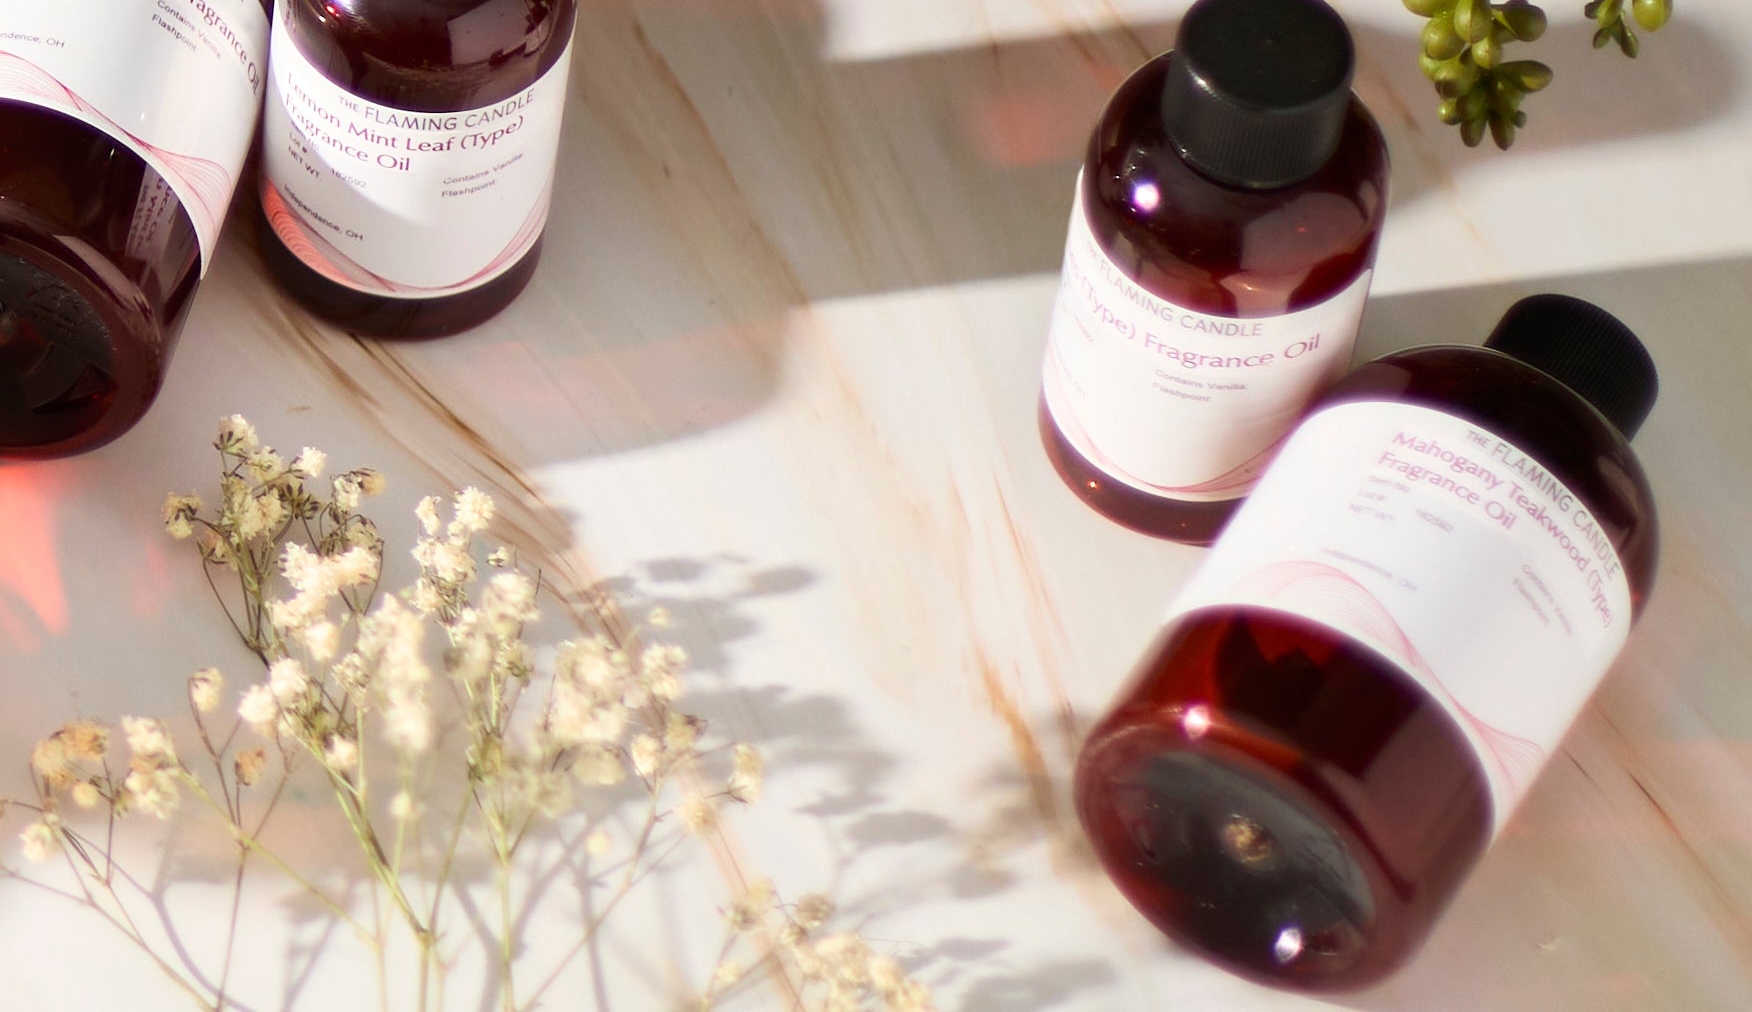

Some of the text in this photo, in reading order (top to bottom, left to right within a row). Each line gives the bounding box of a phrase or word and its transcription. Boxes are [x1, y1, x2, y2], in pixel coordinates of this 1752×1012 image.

[46, 37, 66, 49] OH
[157, 0, 196, 32] Contains
[247, 61, 260, 96] Oil
[288, 71, 524, 152] Lemon Mint Leaf (Type)
[339, 88, 535, 131] THE FLAMING CANDLE
[286, 93, 410, 171] Fragrance Oil
[1080, 276, 1136, 340] (Type)
[1144, 332, 1276, 369] Fragrance
[1283, 332, 1322, 359] Oil
[1099, 258, 1175, 323] FLAMING
[1180, 314, 1264, 338] CANDLE
[1378, 450, 1518, 530] Fragrance Oil
[1392, 430, 1504, 491] Mahogany
[1507, 480, 1590, 573] Teakwood
[1586, 569, 1614, 629] (Type)
[1491, 441, 1574, 514] FLAMING
[1572, 510, 1620, 581] CANDLE
